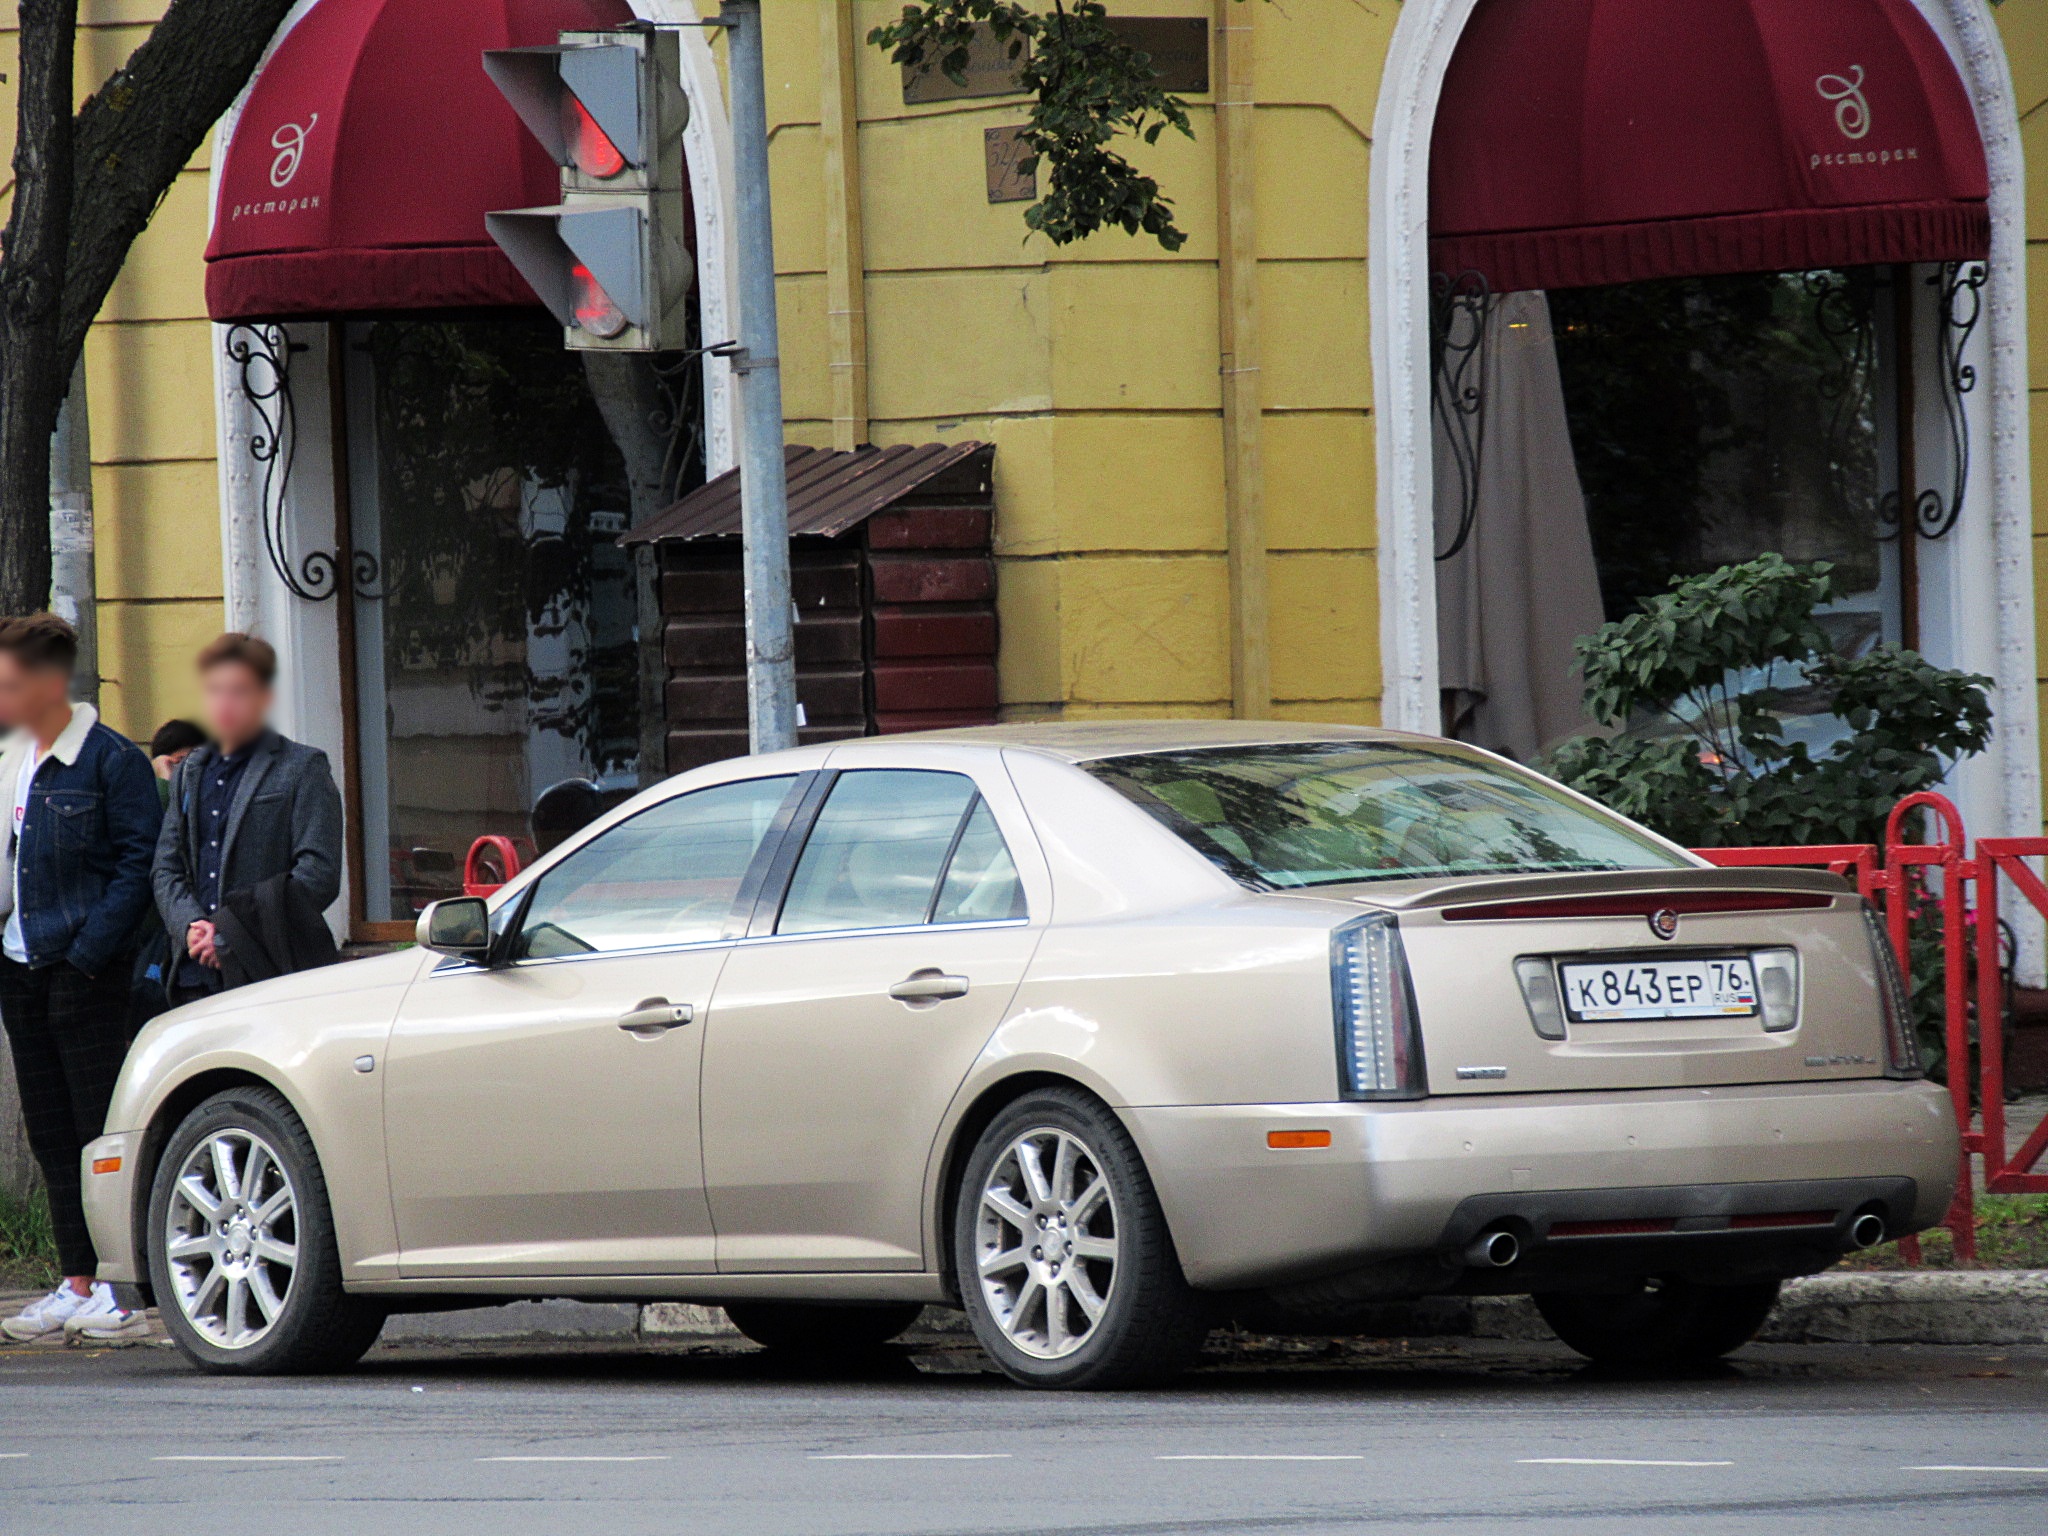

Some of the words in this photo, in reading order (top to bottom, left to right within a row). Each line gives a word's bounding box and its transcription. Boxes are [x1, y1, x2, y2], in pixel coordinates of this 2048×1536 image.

[1810, 148, 1917, 170] ресторан
[232, 196, 320, 221] ресторан
[1710, 963, 1743, 992] 76
[1713, 992, 1738, 1004] RUS
